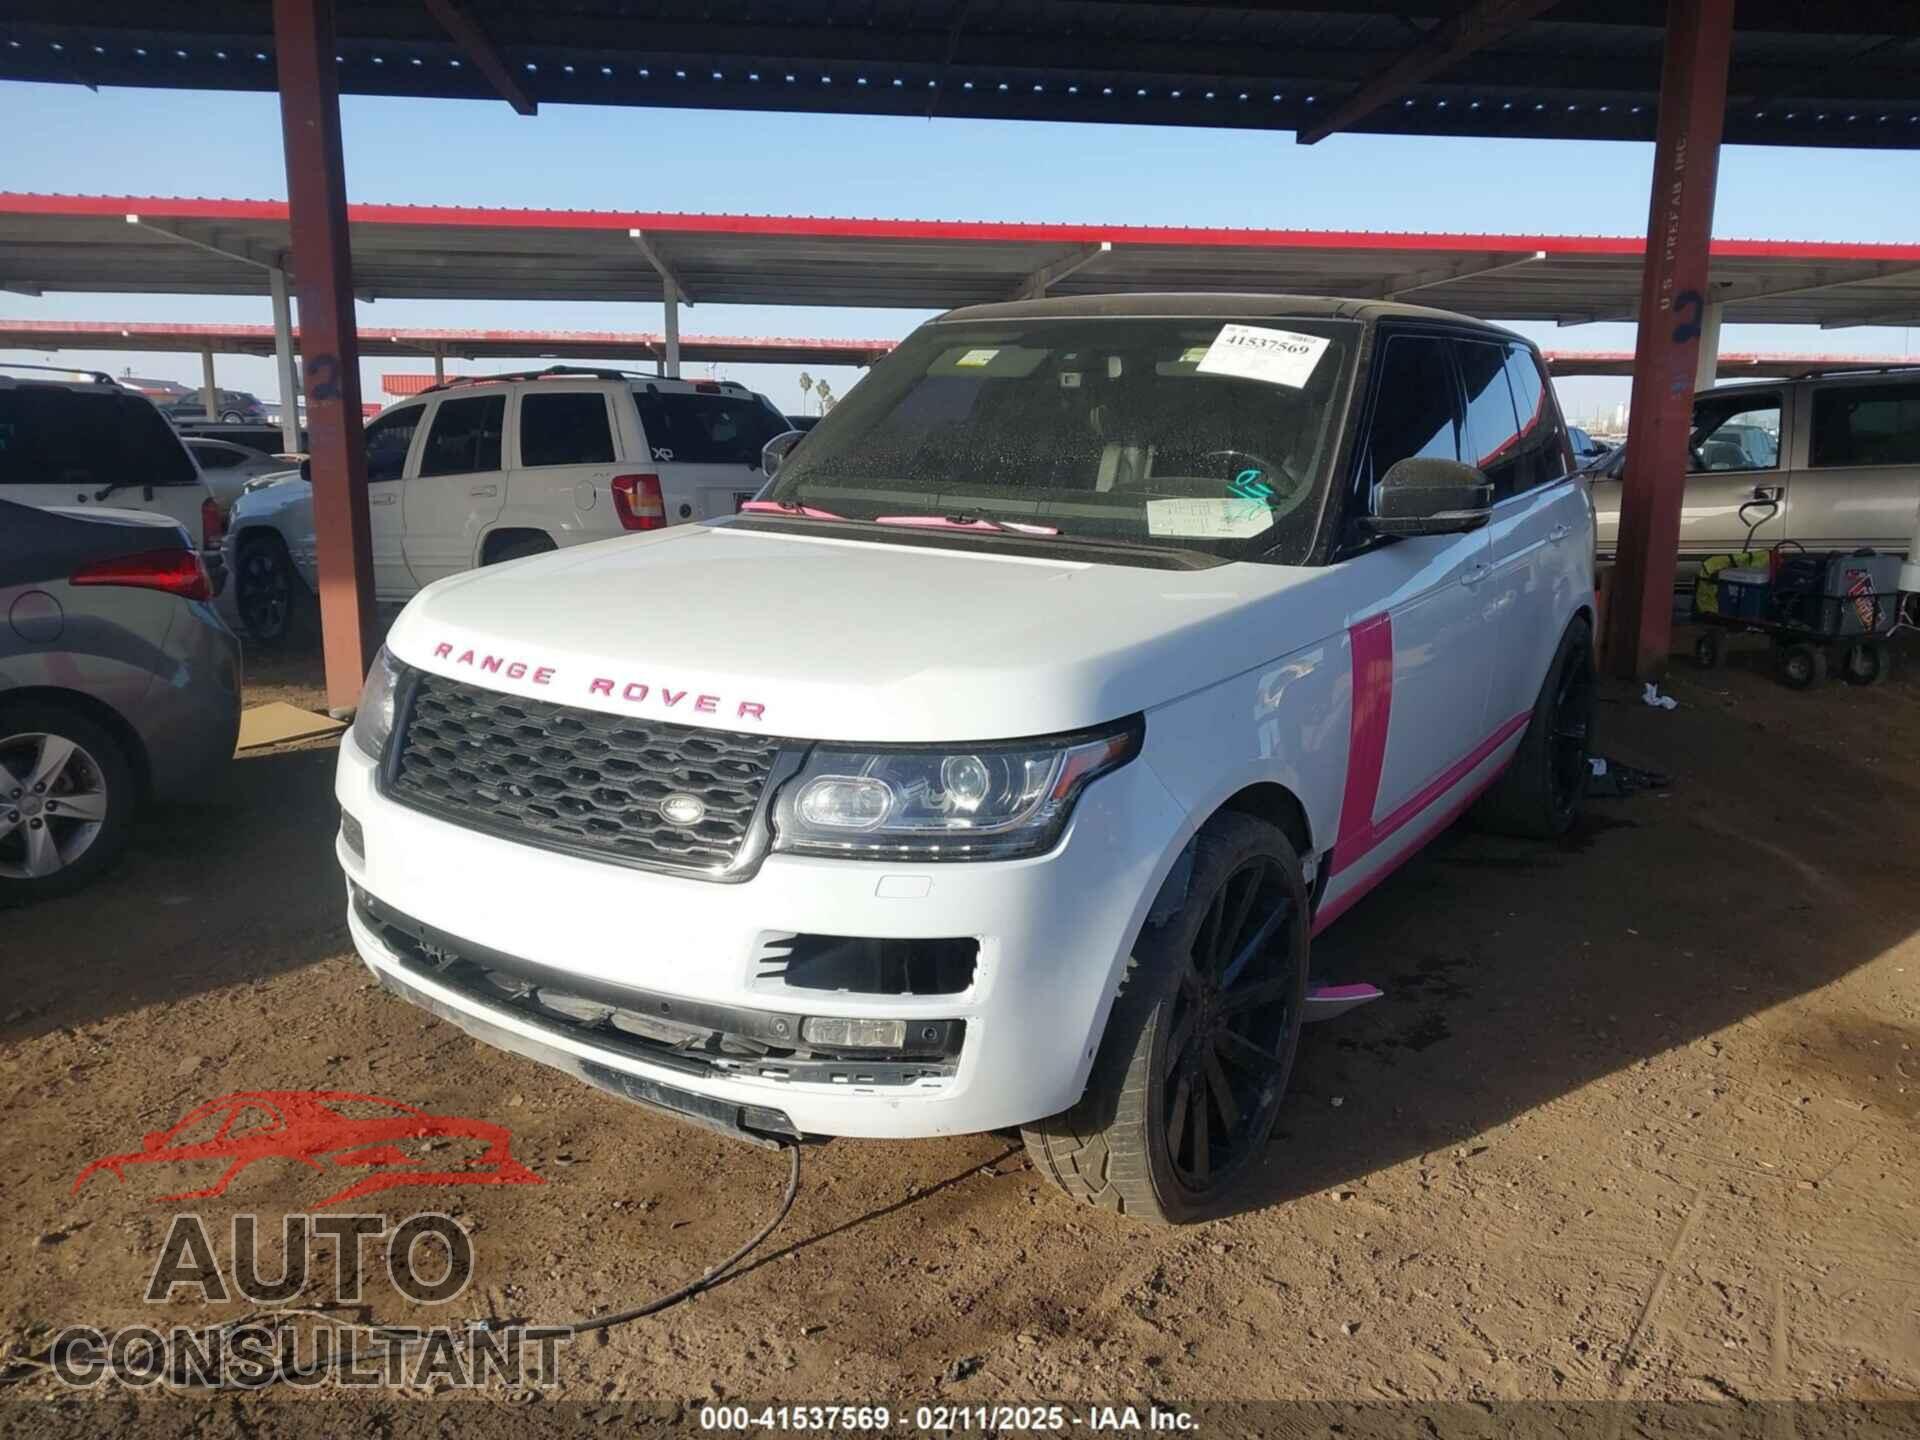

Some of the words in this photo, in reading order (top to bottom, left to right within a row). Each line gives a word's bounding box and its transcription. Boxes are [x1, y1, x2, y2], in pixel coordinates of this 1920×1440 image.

[1672, 289, 1704, 343] 2
[1226, 335, 1309, 355] 41537569
[307, 353, 340, 400] 2
[434, 642, 556, 685] RANGE
[589, 678, 767, 720] ROVER
